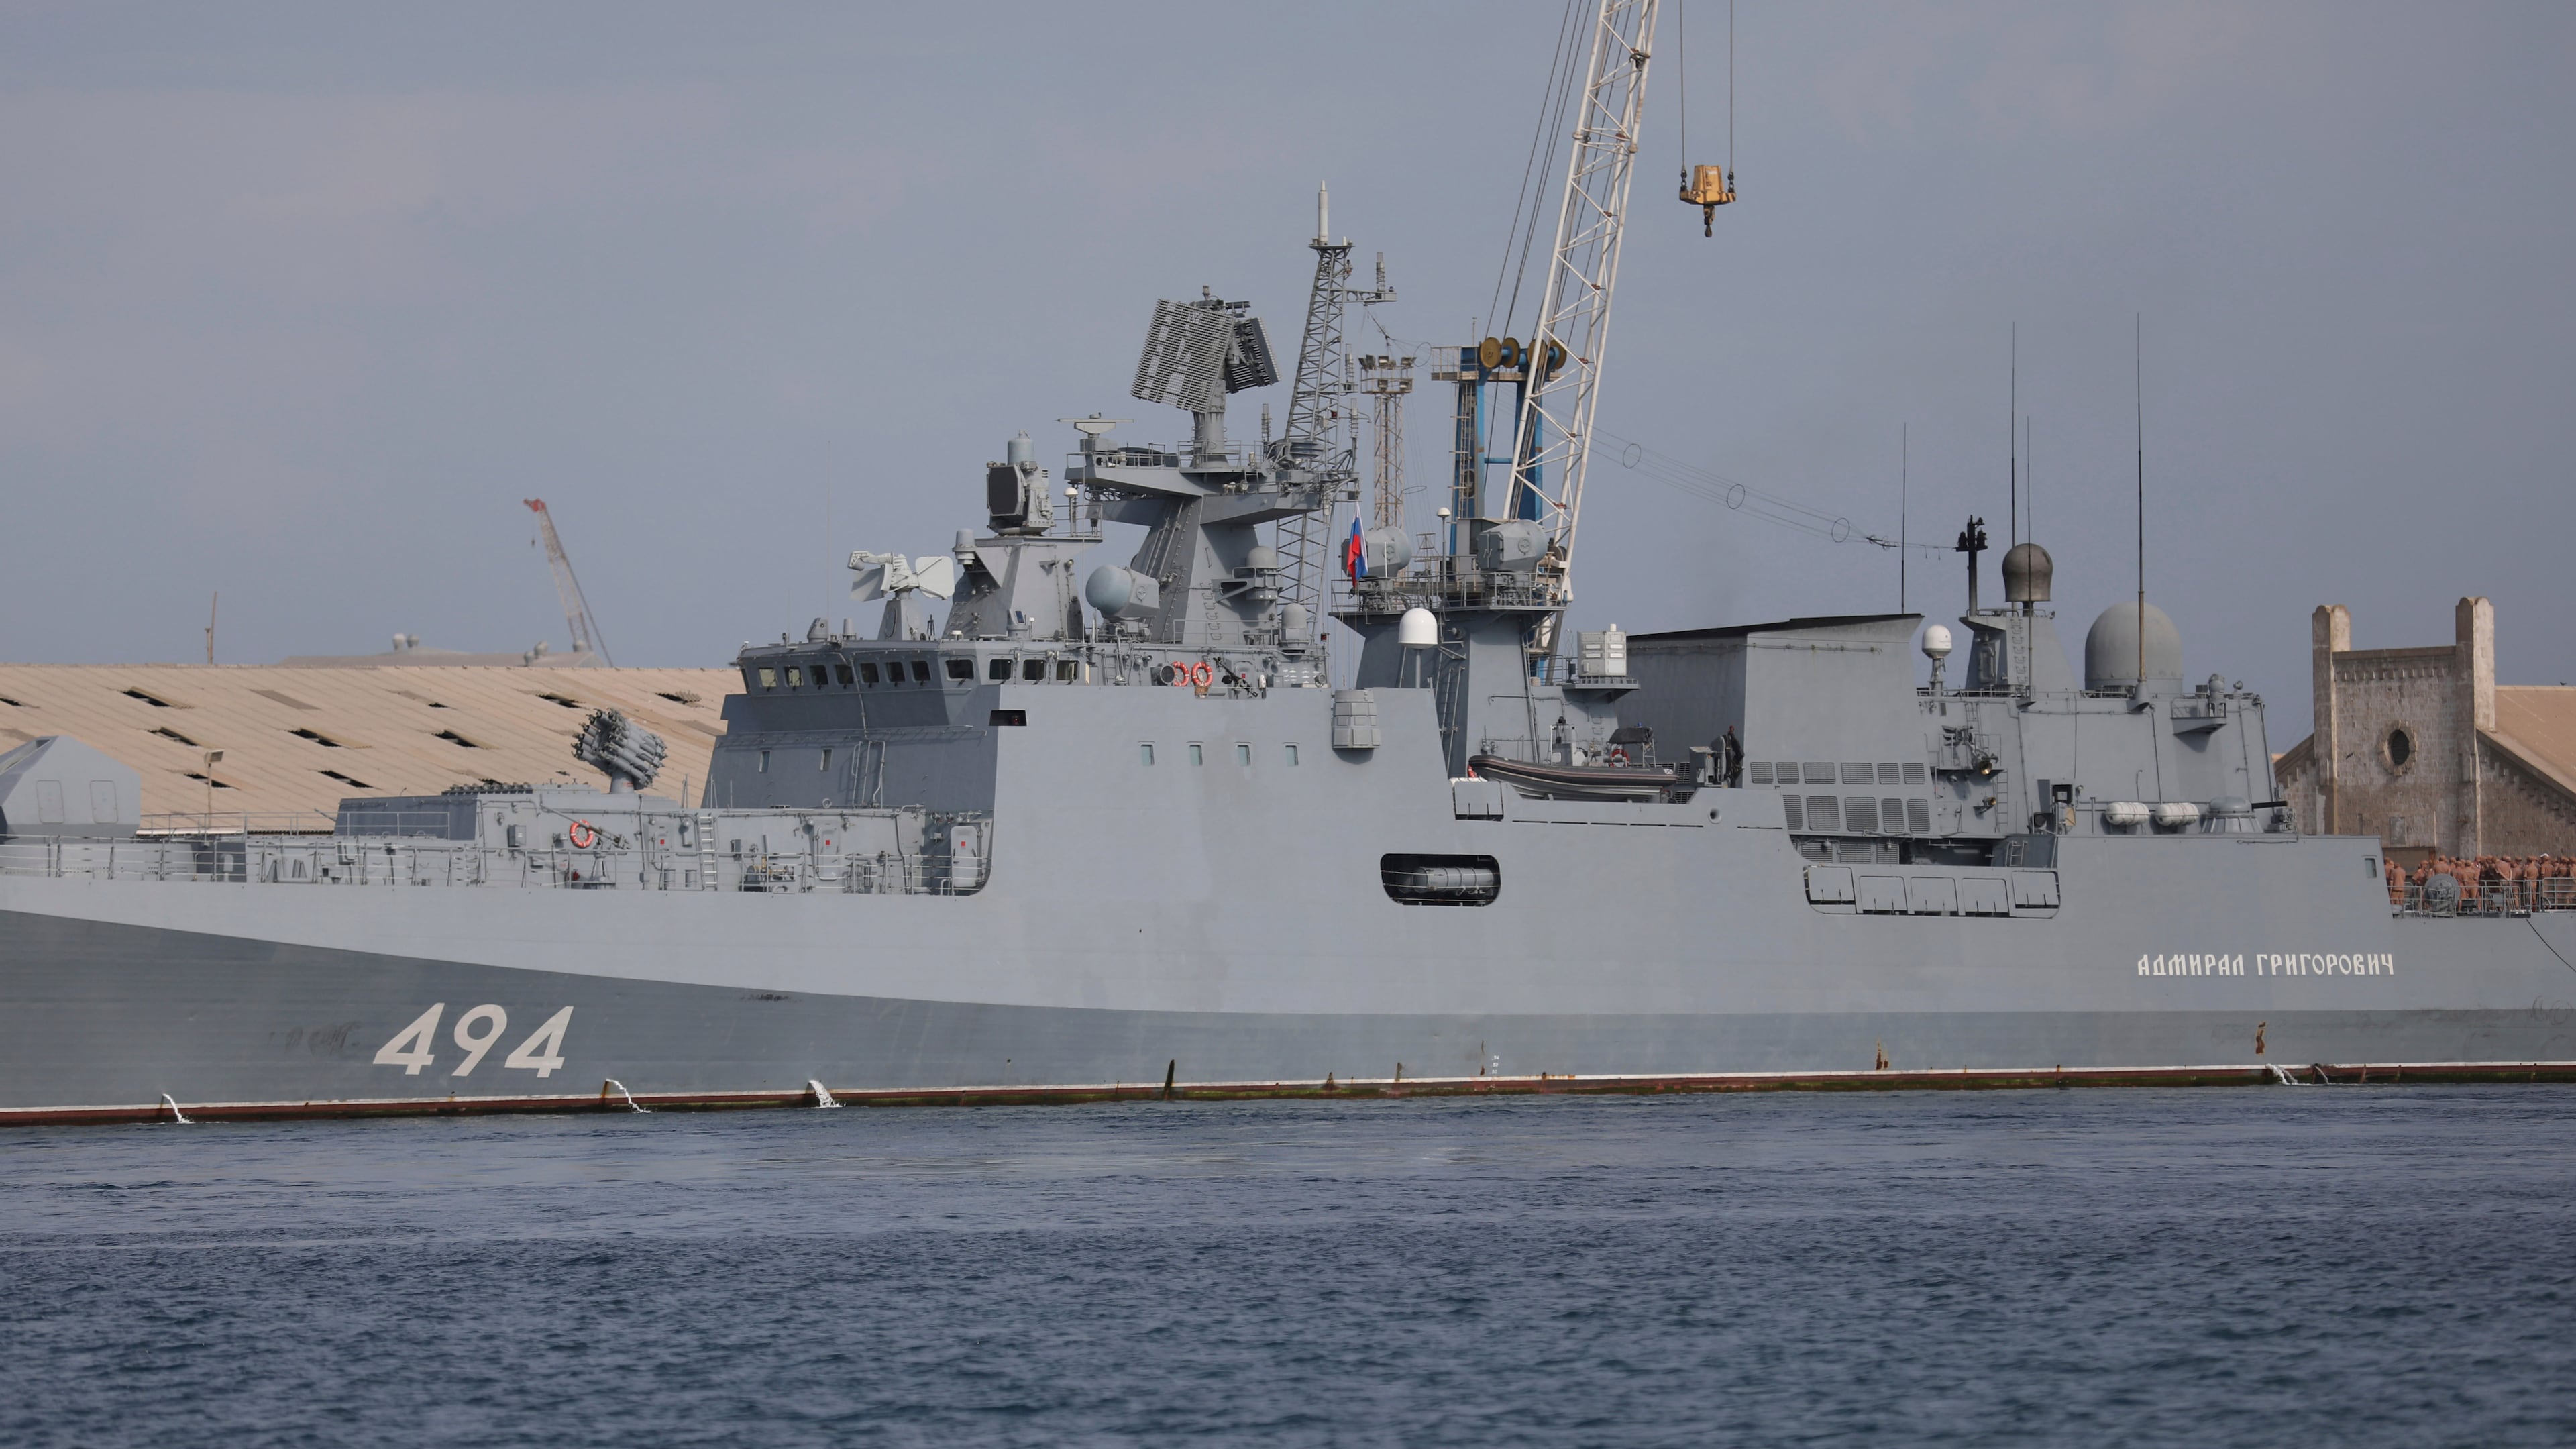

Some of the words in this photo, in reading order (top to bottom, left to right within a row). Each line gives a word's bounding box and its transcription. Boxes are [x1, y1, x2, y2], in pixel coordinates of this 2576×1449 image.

[2137, 954, 2245, 976] АДМИРАЛ
[2256, 953, 2395, 976] ГРИГОРОВИЧ
[372, 1002, 574, 1078] 494
